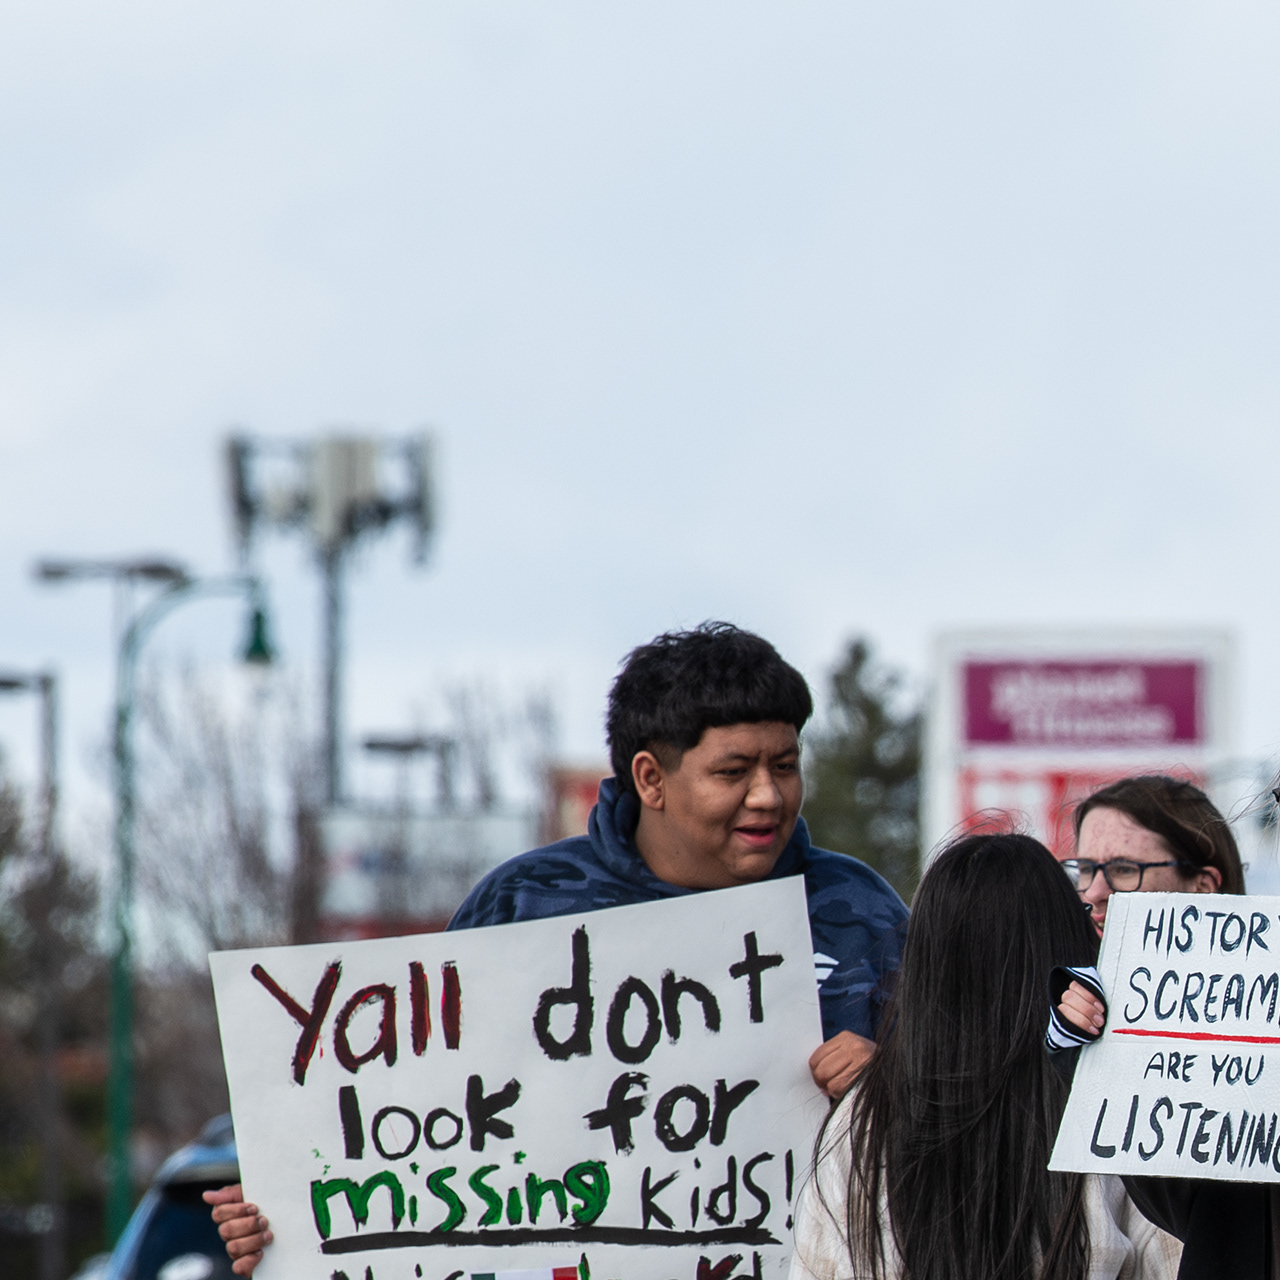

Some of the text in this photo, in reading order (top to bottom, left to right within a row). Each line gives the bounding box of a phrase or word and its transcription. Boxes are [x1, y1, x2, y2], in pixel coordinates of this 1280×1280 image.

[251, 925, 784, 1086] Yall dont
[1143, 1051, 1265, 1087] ARE YOU
[338, 1071, 760, 1160] look for
[311, 1151, 611, 1240] missing
